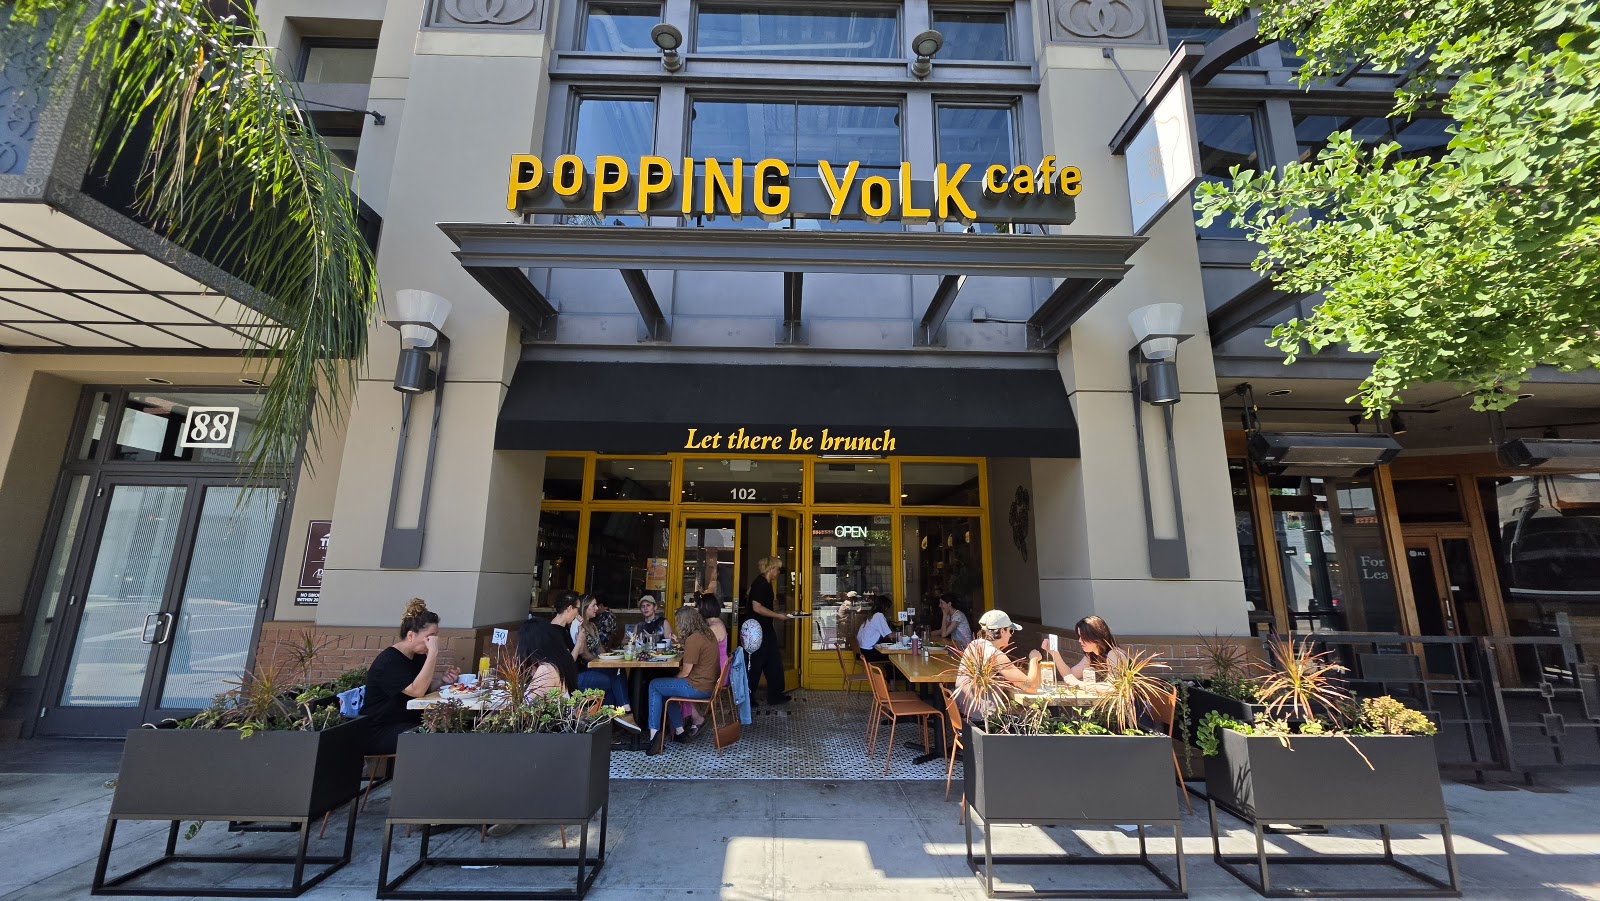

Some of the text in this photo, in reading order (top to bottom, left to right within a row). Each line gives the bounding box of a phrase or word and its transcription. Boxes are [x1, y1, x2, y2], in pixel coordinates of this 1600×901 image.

[986, 154, 1082, 196] cafe
[190, 413, 230, 441] 88
[684, 427, 896, 451] Let there be brunch
[730, 487, 756, 500] 102
[834, 525, 868, 539] OPEN
[1360, 555, 1386, 567] For
